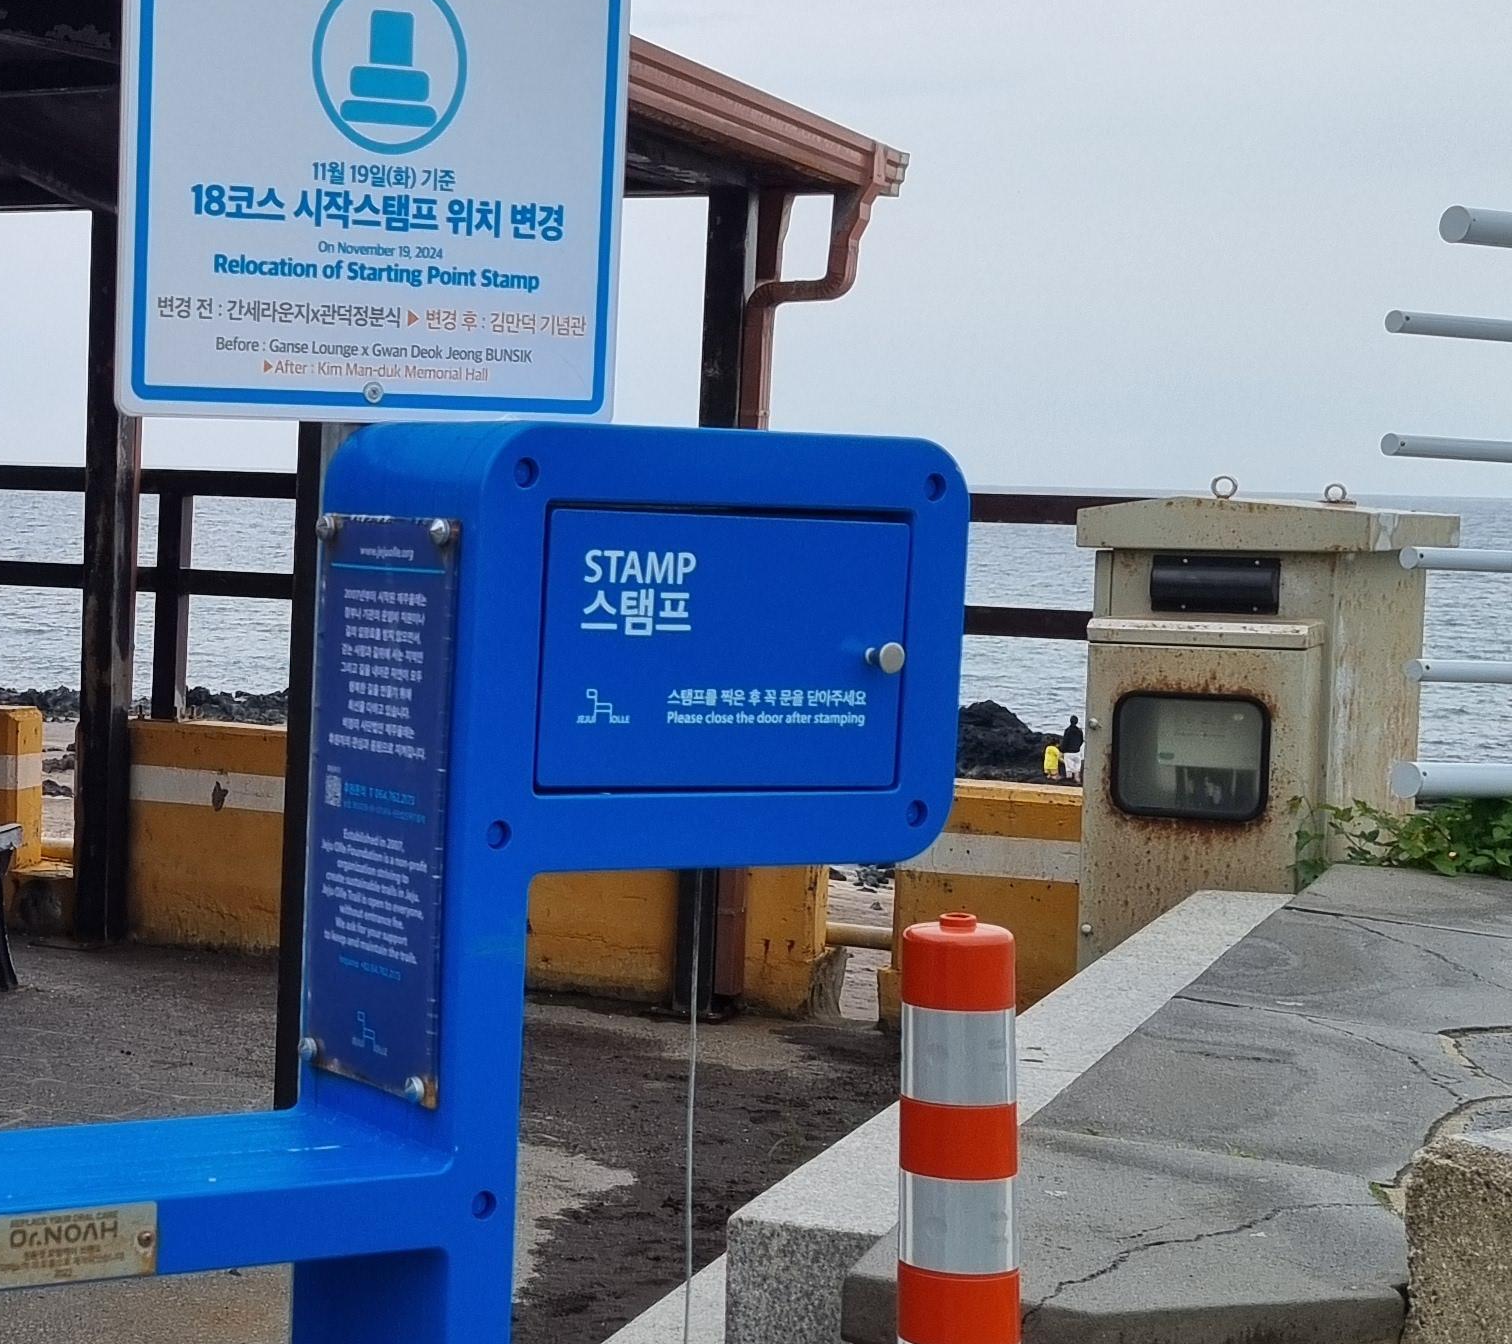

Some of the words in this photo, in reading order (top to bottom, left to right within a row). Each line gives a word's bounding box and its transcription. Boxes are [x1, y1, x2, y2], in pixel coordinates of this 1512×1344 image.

[312, 161, 345, 186] 11월
[350, 164, 417, 189] 19일(화)
[421, 167, 456, 193] 기준
[191, 183, 286, 221] 18코스
[293, 188, 439, 233] 시작스탬프
[446, 198, 501, 238] 위치
[510, 202, 565, 241] 변경
[318, 240, 335, 253] On
[338, 241, 396, 257] November
[398, 245, 413, 260] 19,
[415, 246, 443, 260] 2024
[214, 253, 318, 279] Relocation
[322, 259, 344, 280] of
[347, 261, 423, 288] Starting
[427, 265, 477, 287] Point
[481, 268, 540, 293] Stamp
[157, 295, 192, 319] 변경
[196, 297, 214, 320] 전
[426, 309, 458, 331] 변경
[461, 310, 478, 332] 후
[489, 312, 536, 335] 김만덕
[540, 314, 587, 337] 기념관
[215, 336, 259, 352] Before
[269, 339, 309, 354] Ganse
[312, 341, 359, 358] Lounge
[372, 343, 408, 358] Gwan
[411, 344, 443, 360] Deok
[445, 346, 483, 363] Jeong
[485, 347, 533, 363] BUNSIK
[275, 359, 308, 375] After
[317, 361, 343, 376] Kim
[346, 362, 401, 378] Man-duk
[404, 365, 462, 381] Memorial
[465, 367, 489, 382] Hall
[584, 549, 697, 585] STAMP
[580, 588, 692, 636] 스탬프
[667, 688, 717, 706] 스탬프를
[721, 688, 746, 706] 찍은
[748, 688, 761, 706] 후
[764, 689, 777, 706] 꼭
[779, 689, 804, 706] 문을
[807, 689, 867, 707] 닫아주세요
[667, 711, 702, 724] Please
[705, 711, 734, 724] close
[736, 711, 755, 724] the
[756, 711, 784, 724] door
[785, 711, 812, 724] after
[814, 712, 866, 727] stamping
[9, 1219, 119, 1249] Dr.NOAH
